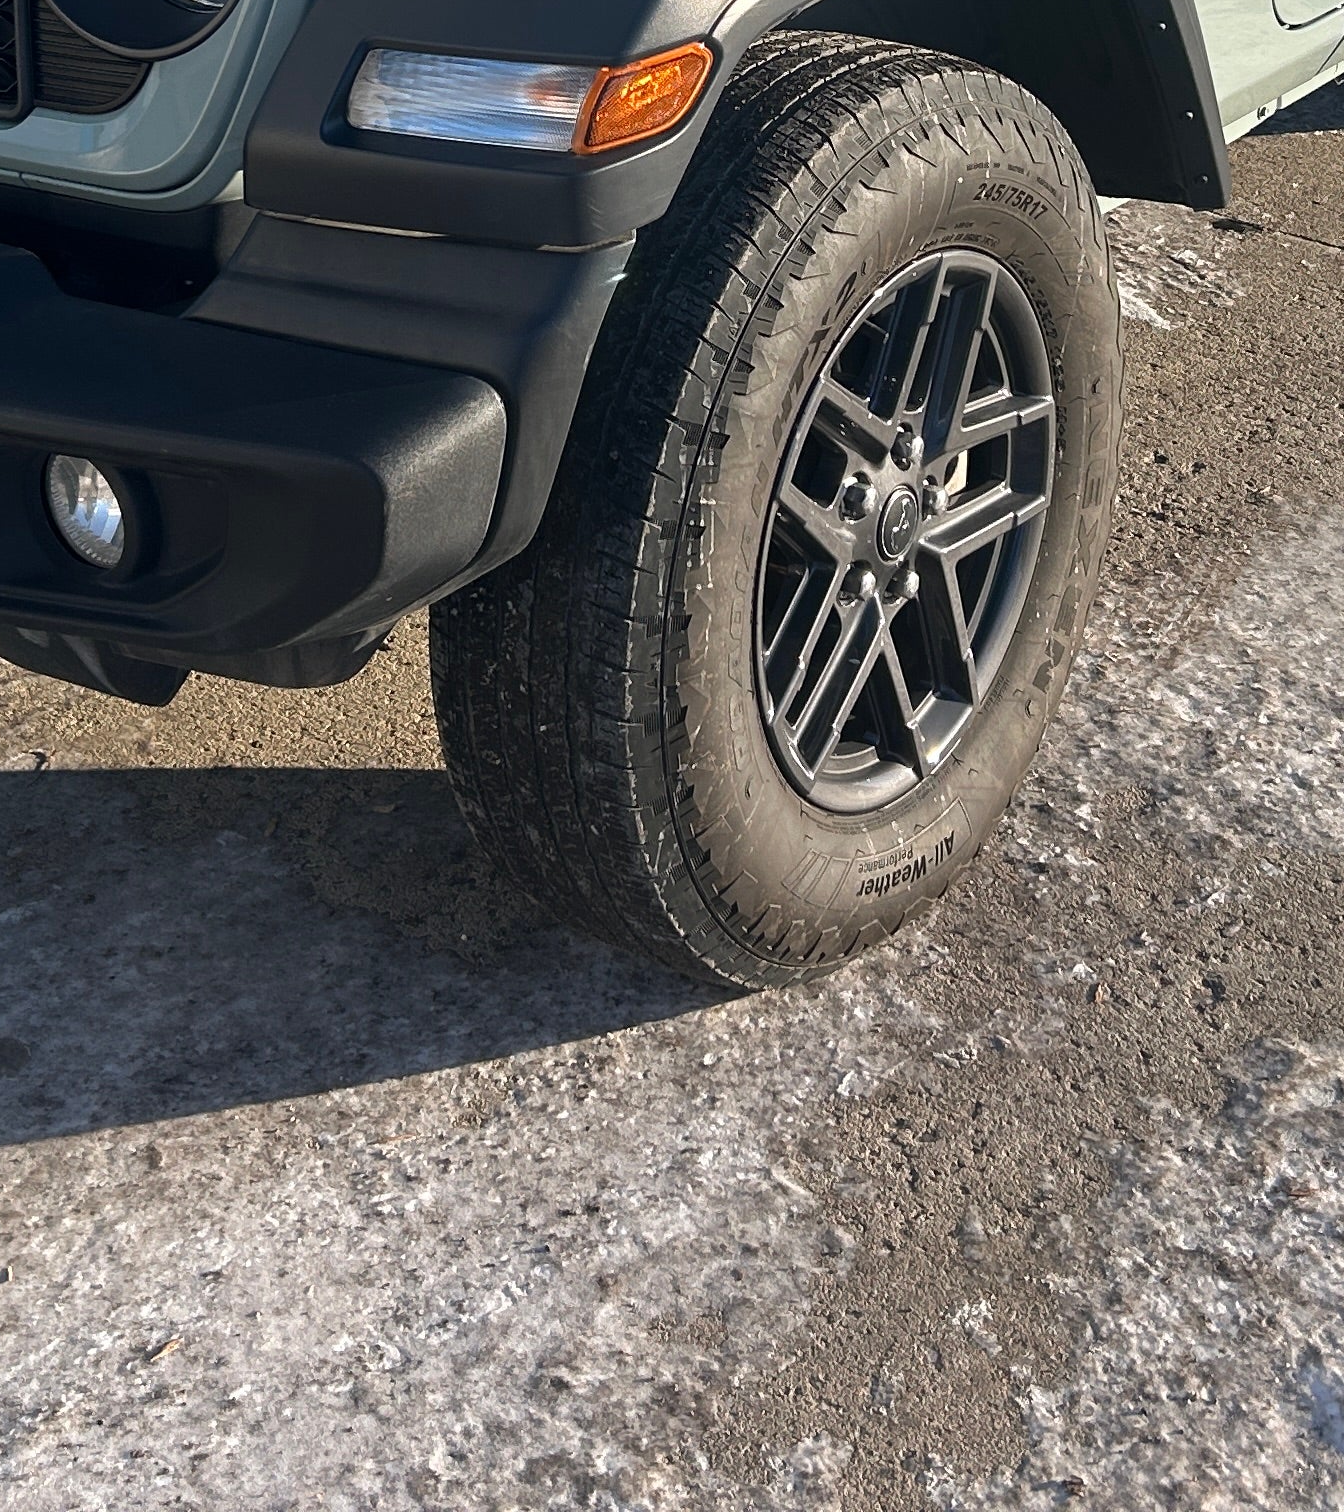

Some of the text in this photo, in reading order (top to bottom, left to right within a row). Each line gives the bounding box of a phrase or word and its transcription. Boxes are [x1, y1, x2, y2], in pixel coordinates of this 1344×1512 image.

[973, 182, 1048, 220] 245/75R17
[856, 830, 955, 899] All-Weather
[857, 846, 914, 874] Performance
